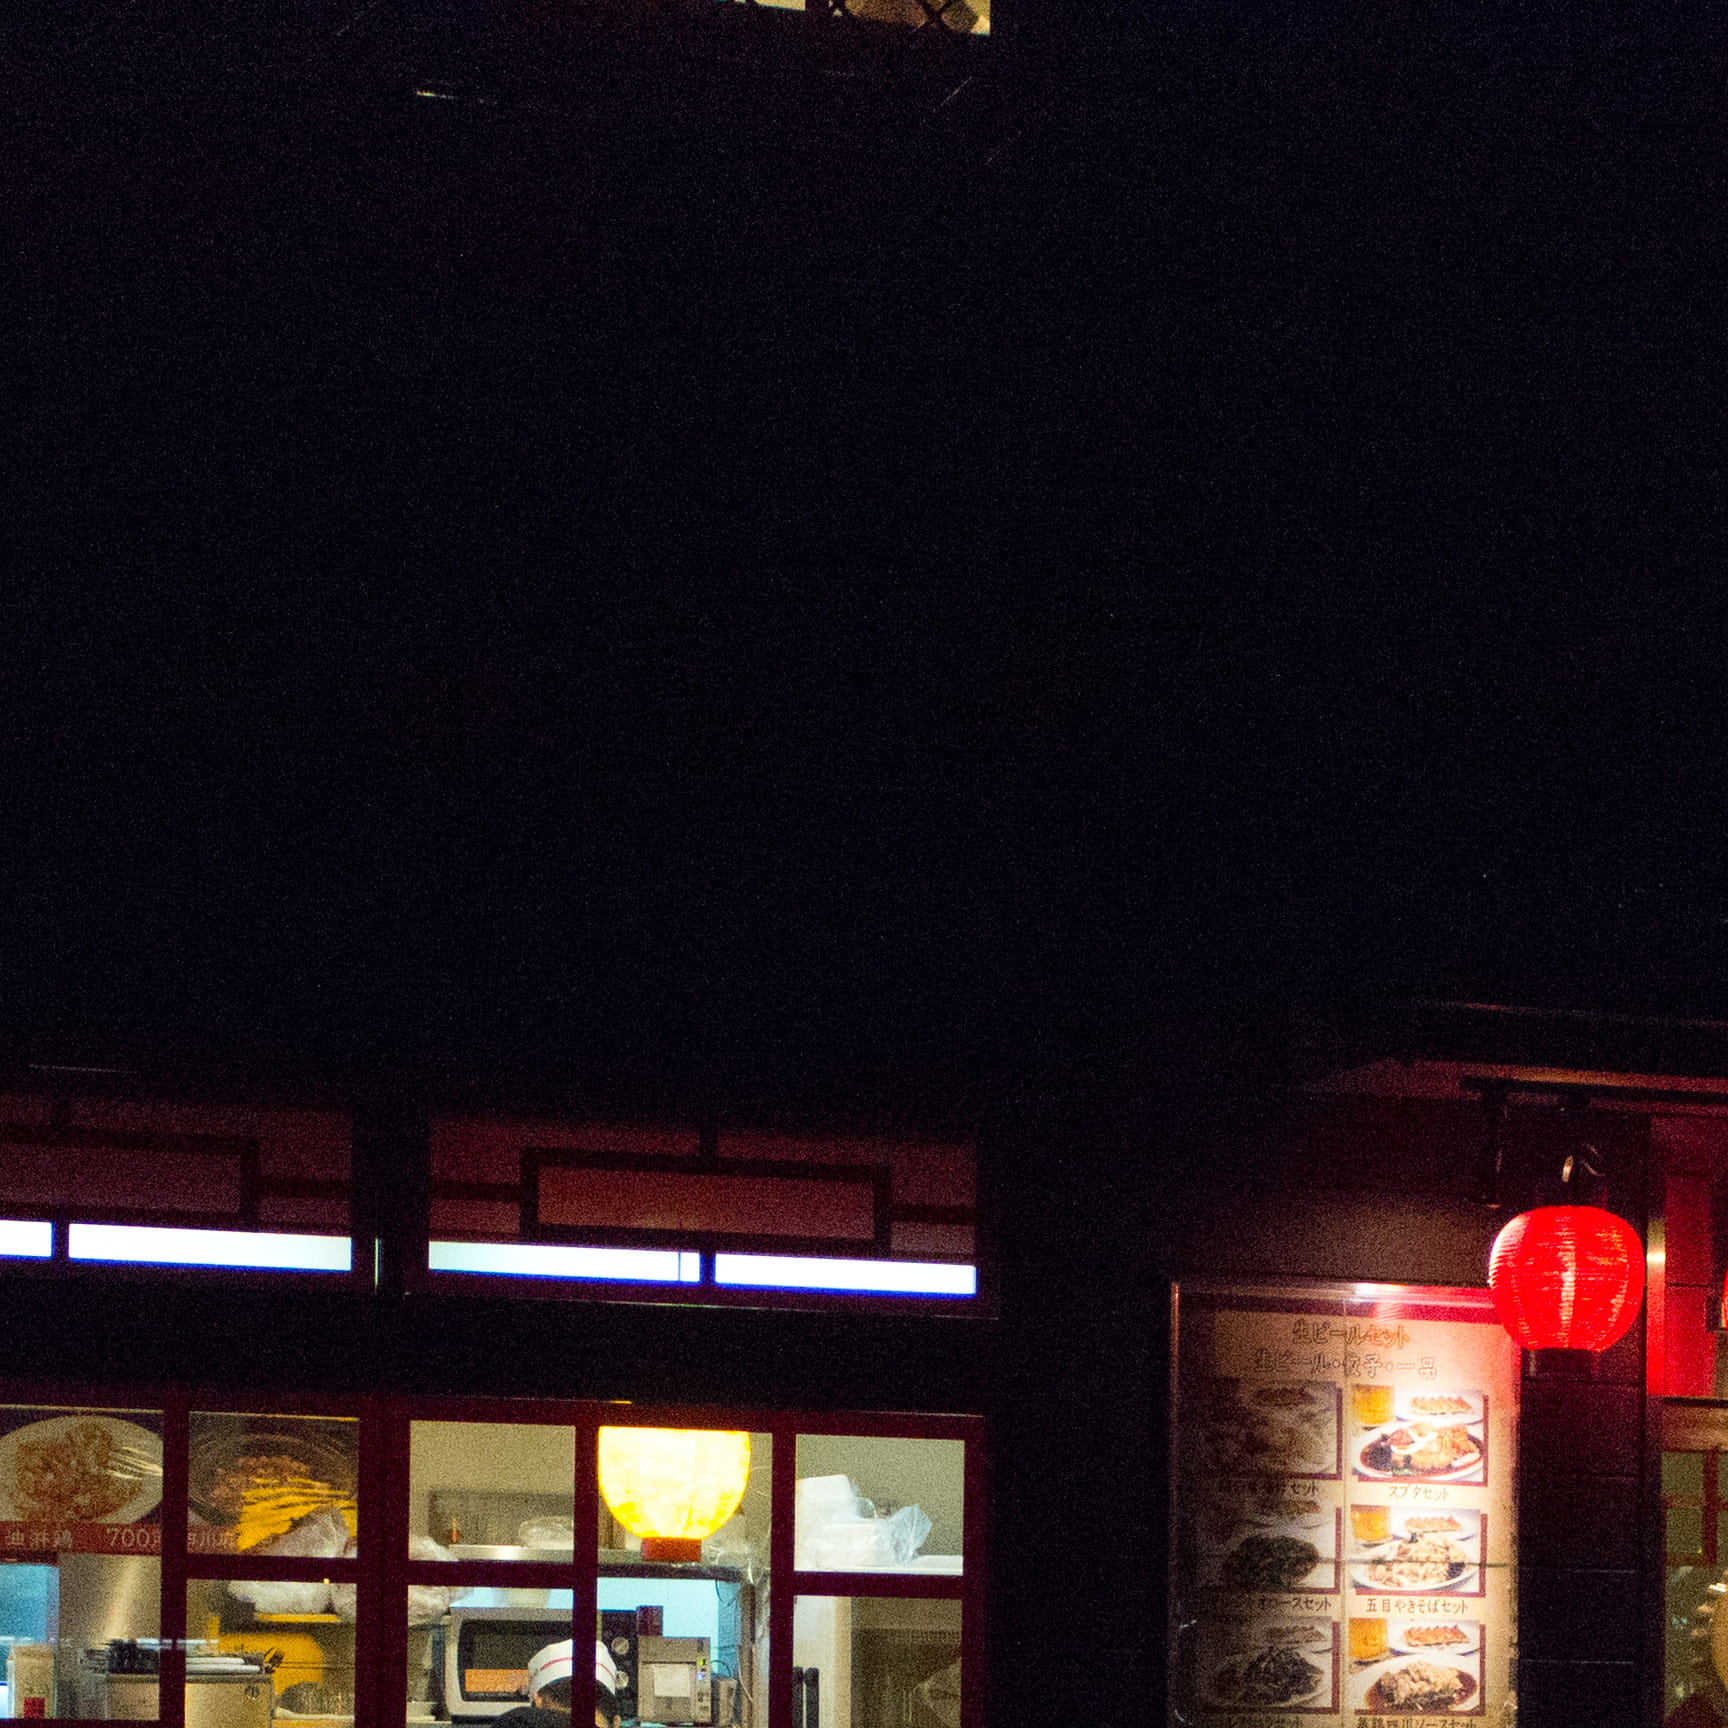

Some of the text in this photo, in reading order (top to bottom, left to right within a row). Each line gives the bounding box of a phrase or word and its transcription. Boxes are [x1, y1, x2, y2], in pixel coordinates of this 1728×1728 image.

[1366, 1597, 1468, 1614] 五目やきそばセット
